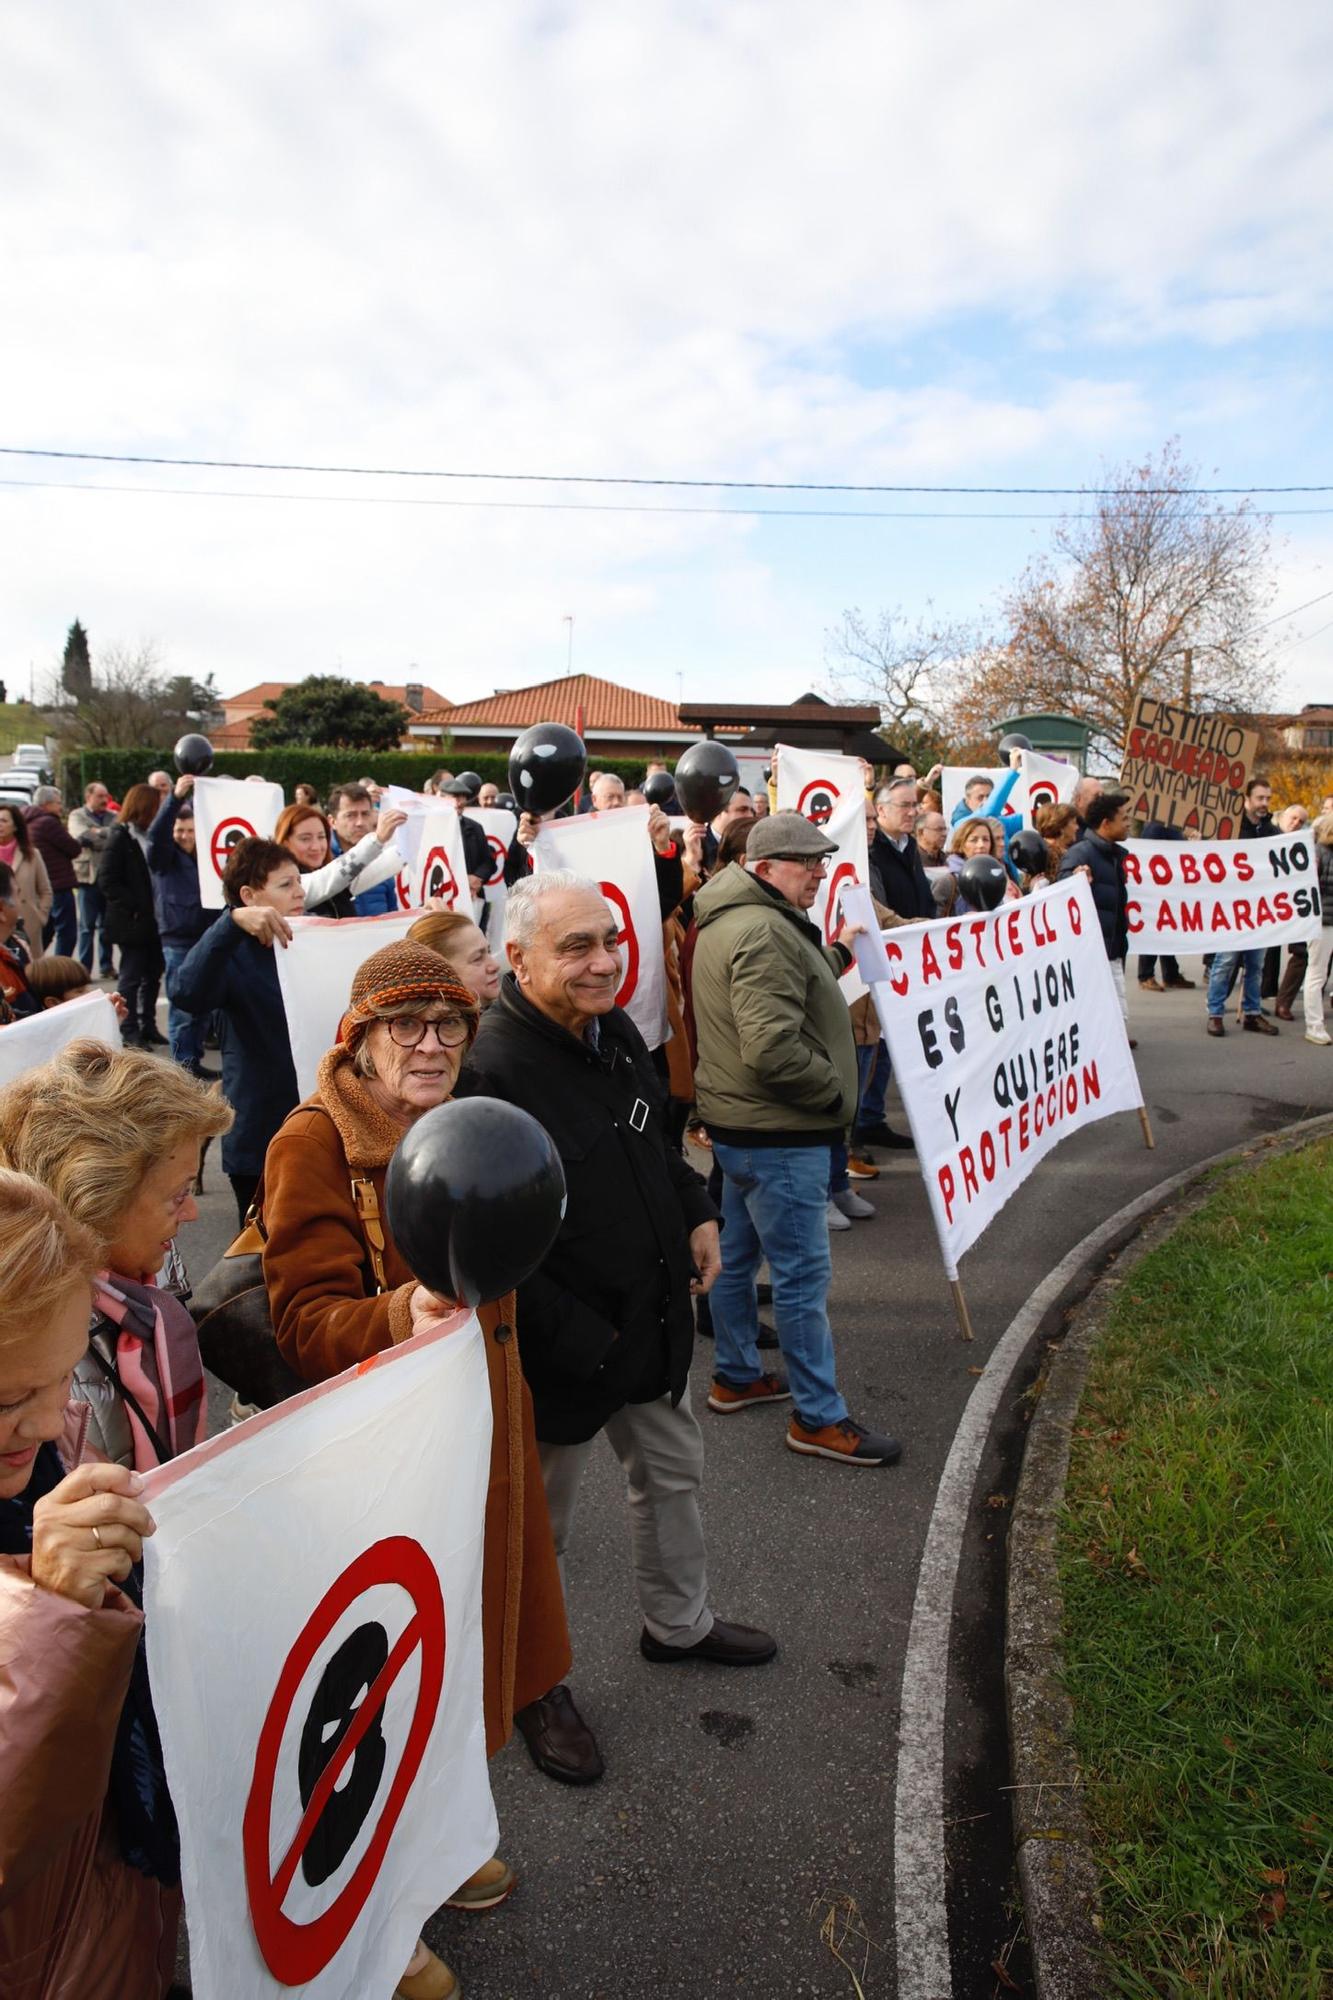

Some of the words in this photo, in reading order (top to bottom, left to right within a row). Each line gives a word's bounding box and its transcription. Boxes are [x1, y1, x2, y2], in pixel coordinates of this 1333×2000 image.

[1128, 728, 1245, 789] SAQUEADO
[1136, 698, 1244, 758] CASTIELLO
[1121, 759, 1245, 815] AYUNTAMIENTO
[1122, 853, 1254, 886] ROBOS
[1269, 842, 1308, 878] NO
[884, 896, 1082, 997] CASTIELLO
[917, 995, 966, 1069] ES
[984, 958, 1076, 1033] GIJON
[944, 1086, 961, 1142] Y
[993, 1023, 1080, 1109] QUIERE
[937, 1059, 1102, 1225] PROTECCION
